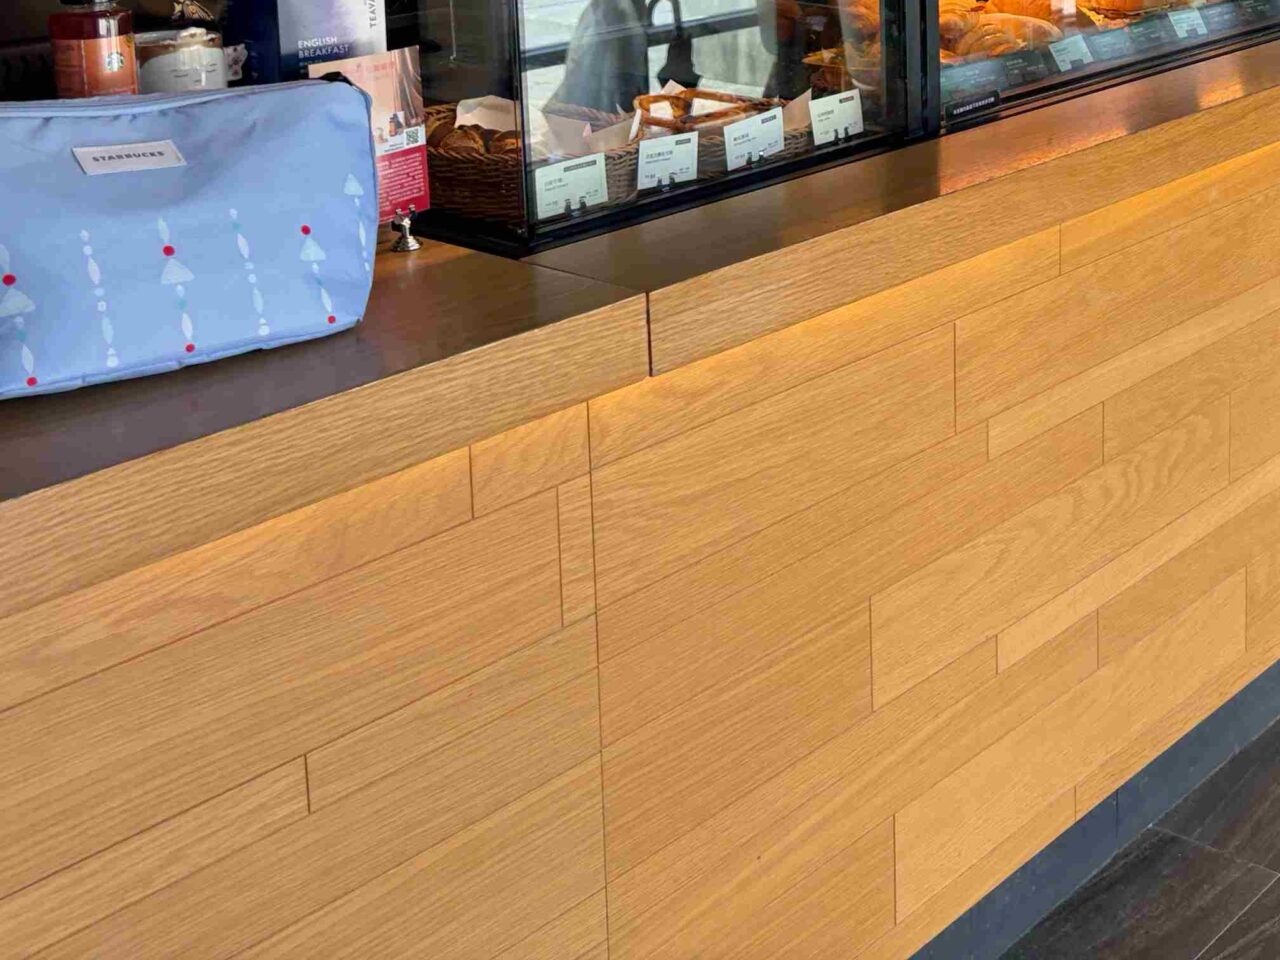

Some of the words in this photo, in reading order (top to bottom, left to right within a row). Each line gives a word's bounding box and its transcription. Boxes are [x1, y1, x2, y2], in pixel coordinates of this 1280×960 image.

[297, 36, 338, 49] ENGLISH
[298, 44, 349, 59] BREAKFAST
[92, 151, 165, 162] STARBUCKS
